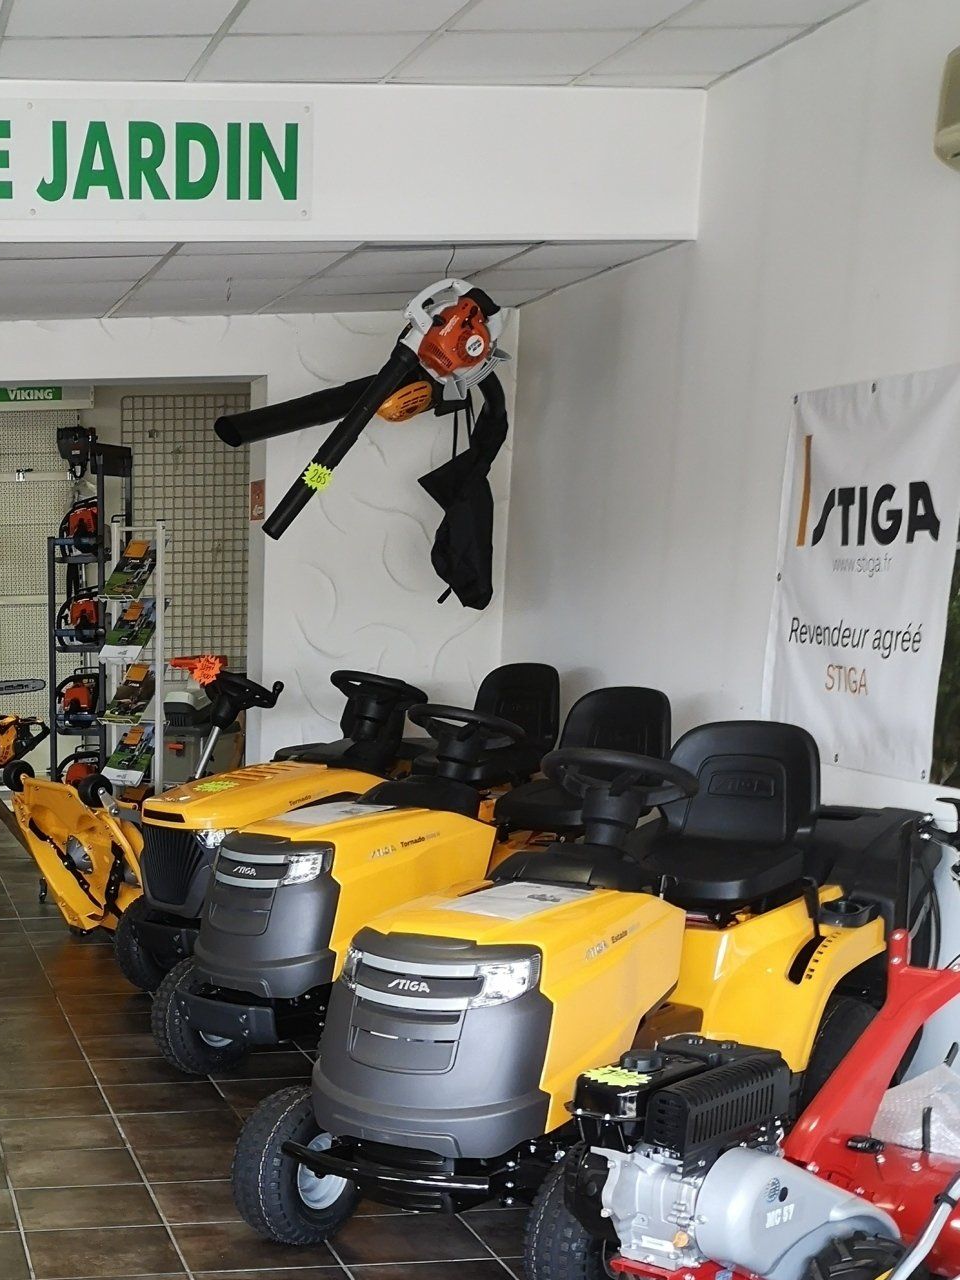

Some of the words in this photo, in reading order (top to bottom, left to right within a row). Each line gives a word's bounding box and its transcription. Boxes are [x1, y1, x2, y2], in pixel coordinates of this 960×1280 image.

[36, 120, 299, 202] JARDIN
[7, 387, 54, 400] VIKING
[811, 481, 940, 547] STIGA
[831, 555, 894, 578] www.stiga.fr
[788, 617, 870, 650] Revendeur
[871, 623, 923, 660] agréé
[825, 664, 869, 696] STIGA
[400, 834, 426, 848] Tornado
[233, 865, 257, 876] STIGA
[387, 978, 430, 994] STIGA
